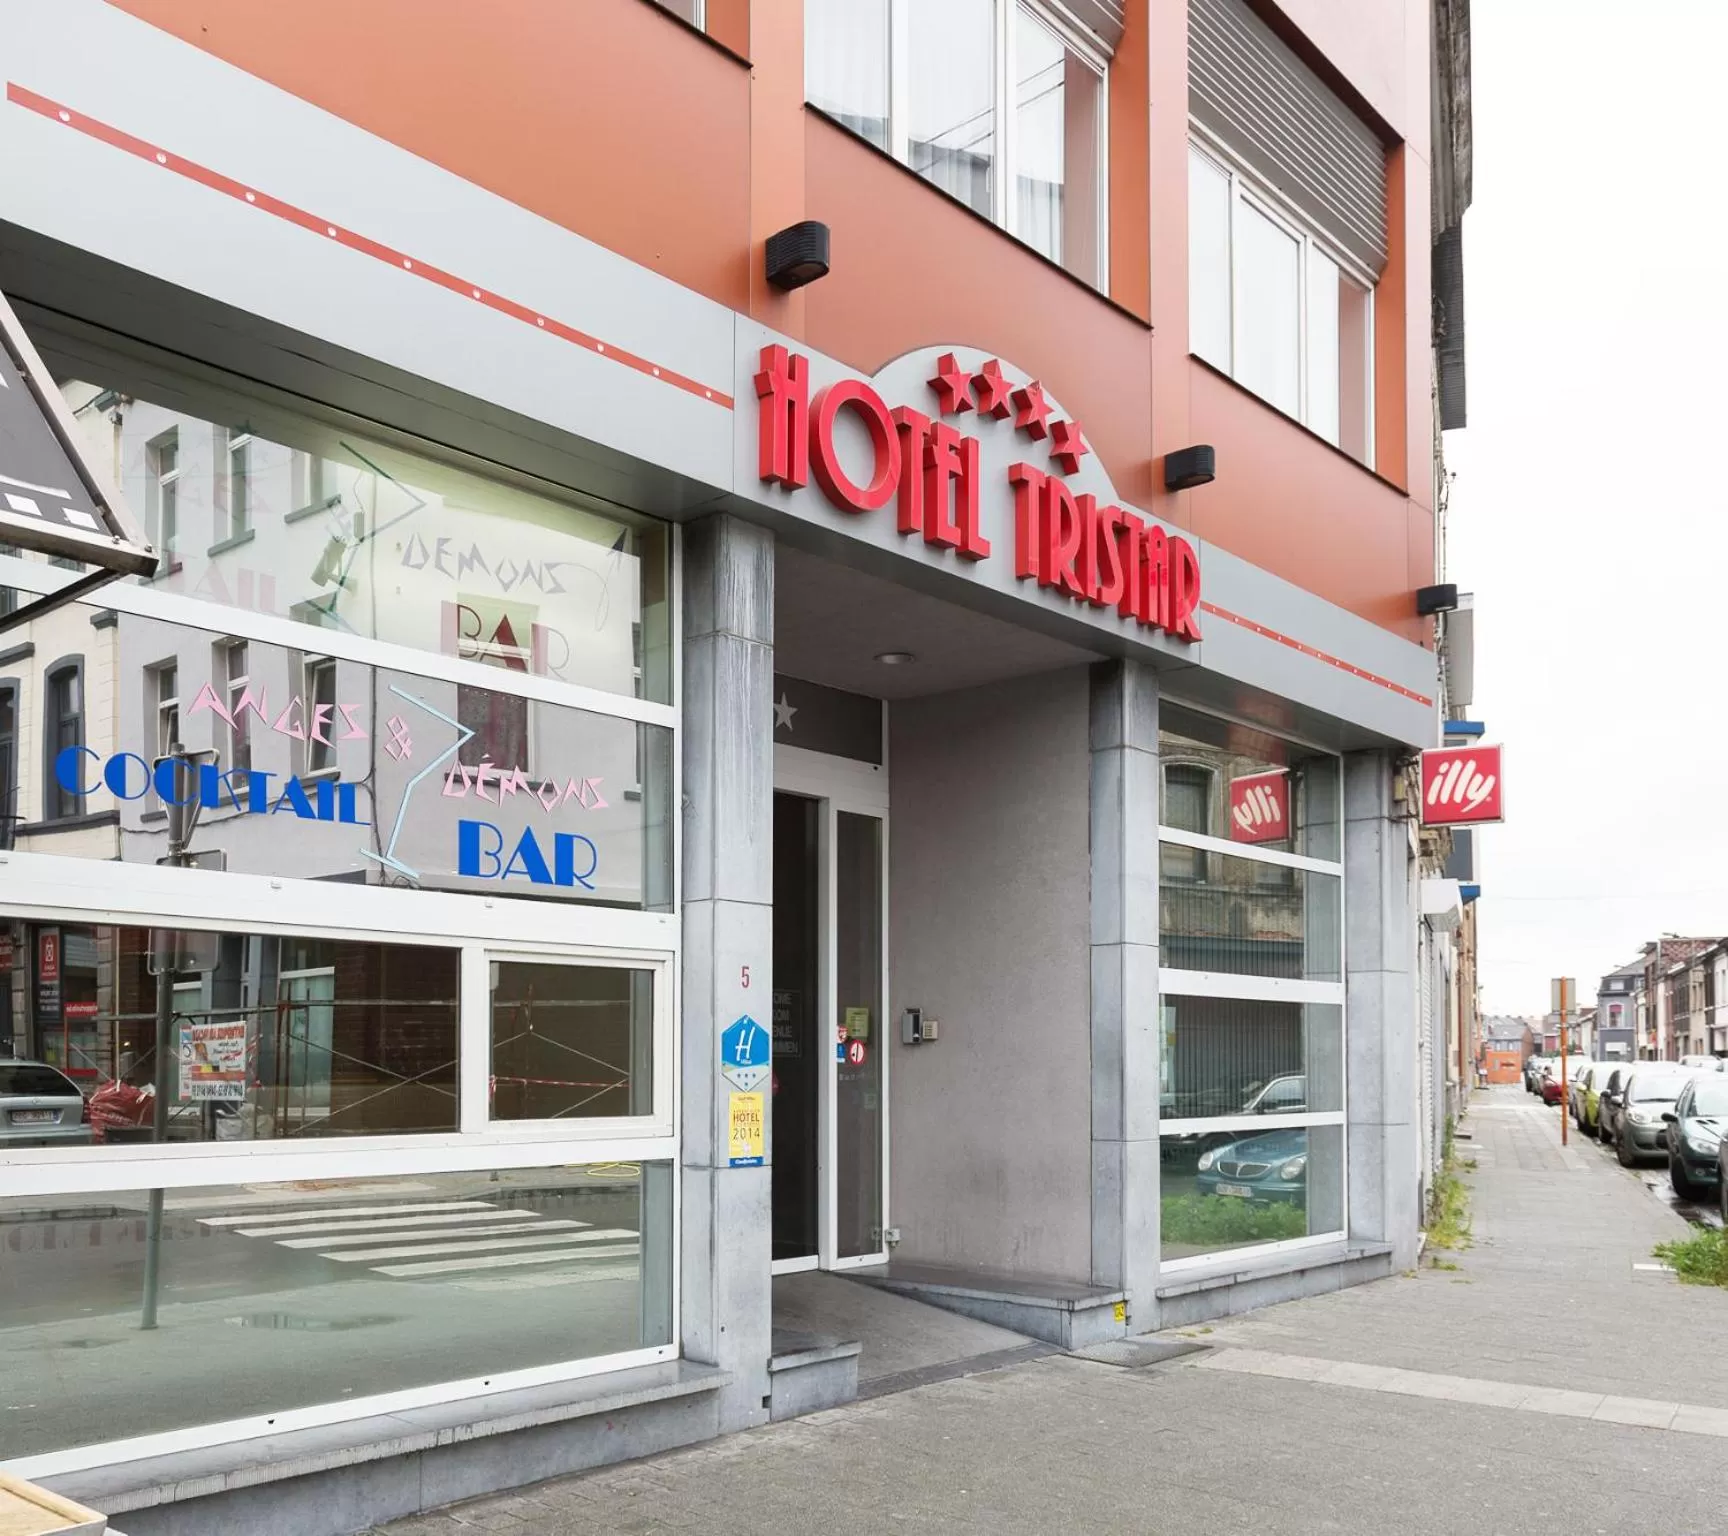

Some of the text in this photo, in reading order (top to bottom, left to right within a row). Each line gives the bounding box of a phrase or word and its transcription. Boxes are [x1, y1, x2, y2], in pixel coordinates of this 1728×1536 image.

[753, 343, 1202, 644] HOTEL TRISTAR
[441, 600, 570, 682] BAR
[187, 680, 610, 813] ANGES & DÉMONS
[55, 745, 597, 890] COCKTAIL BAR
[1427, 759, 1496, 813] illy
[741, 966, 750, 988] 5
[733, 1111, 760, 1123] HOTEL
[733, 1127, 760, 1140] 2014
